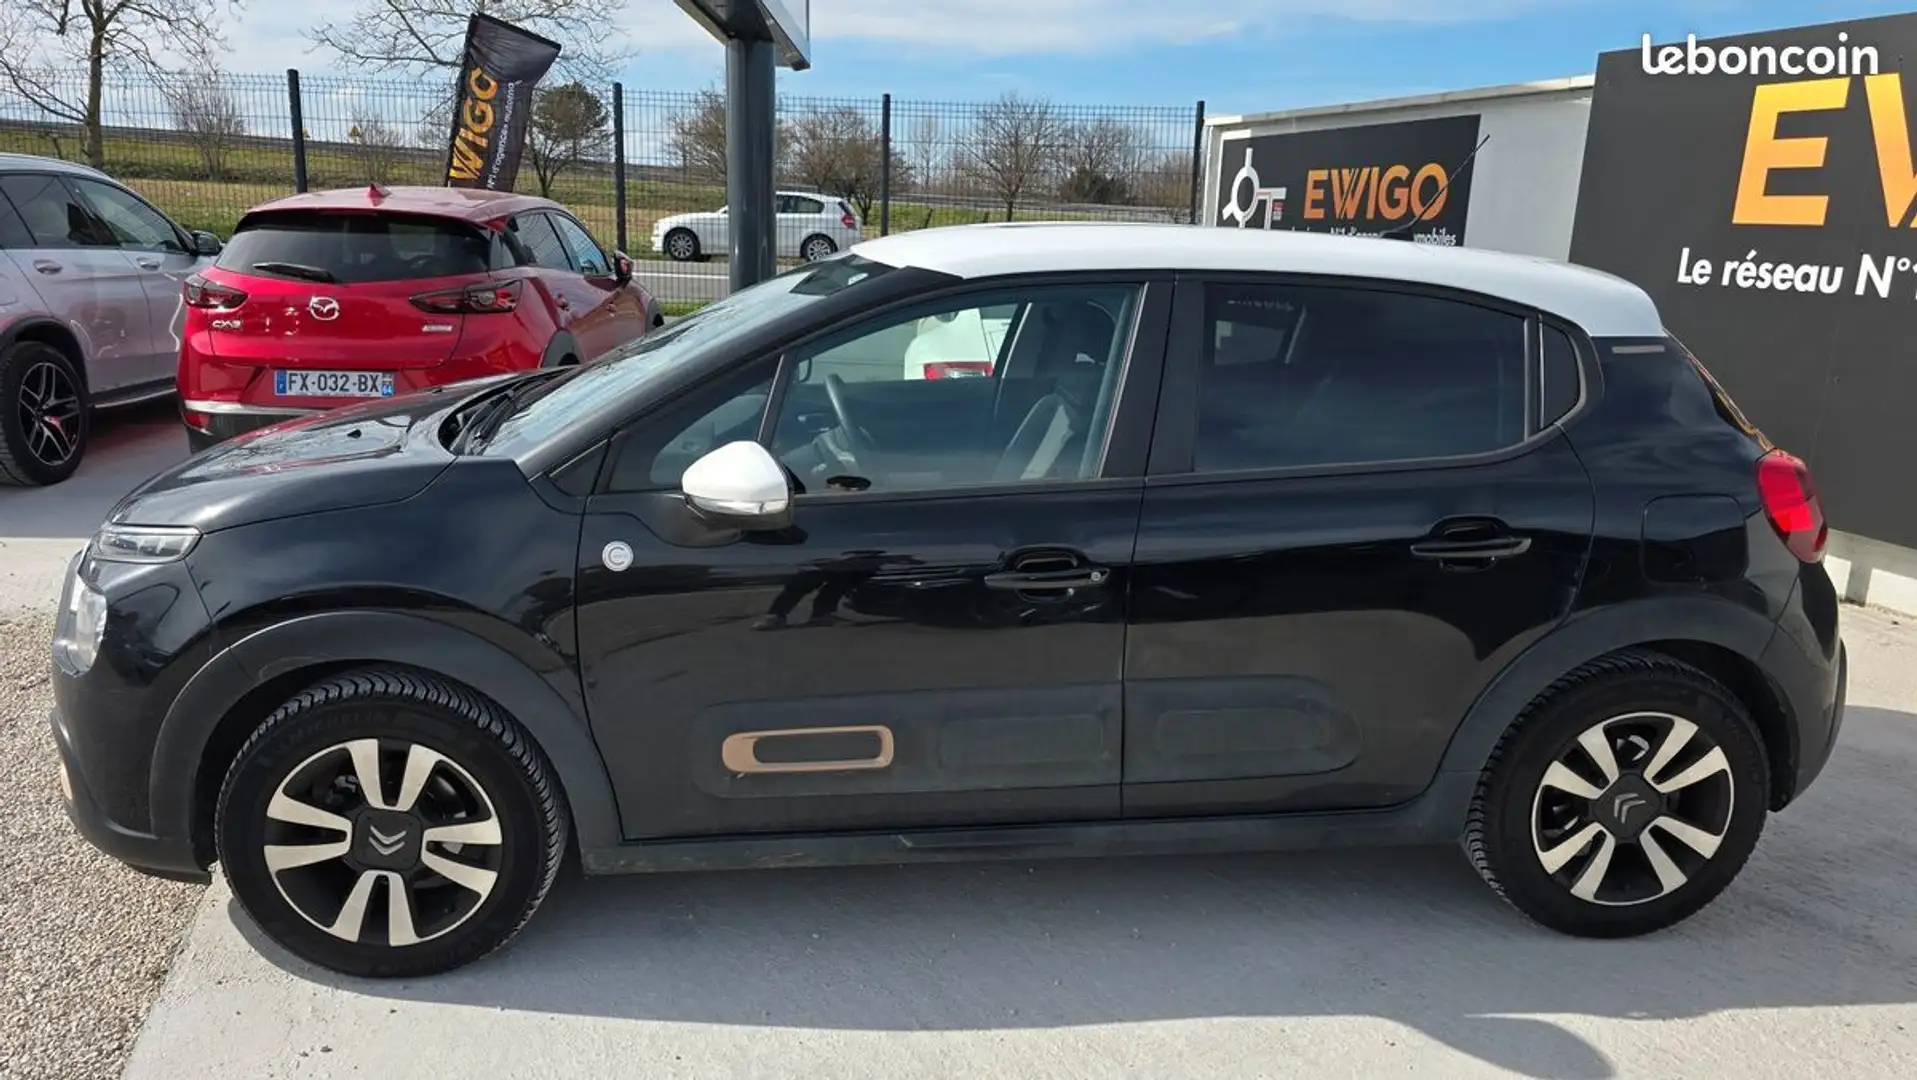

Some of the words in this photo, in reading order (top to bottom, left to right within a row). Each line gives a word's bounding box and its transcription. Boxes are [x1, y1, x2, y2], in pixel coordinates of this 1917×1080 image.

[1303, 163, 1448, 220] EWIGO
[1677, 247, 1712, 285] Le
[1721, 249, 1844, 294] réseau
[1855, 253, 1917, 299] N°
